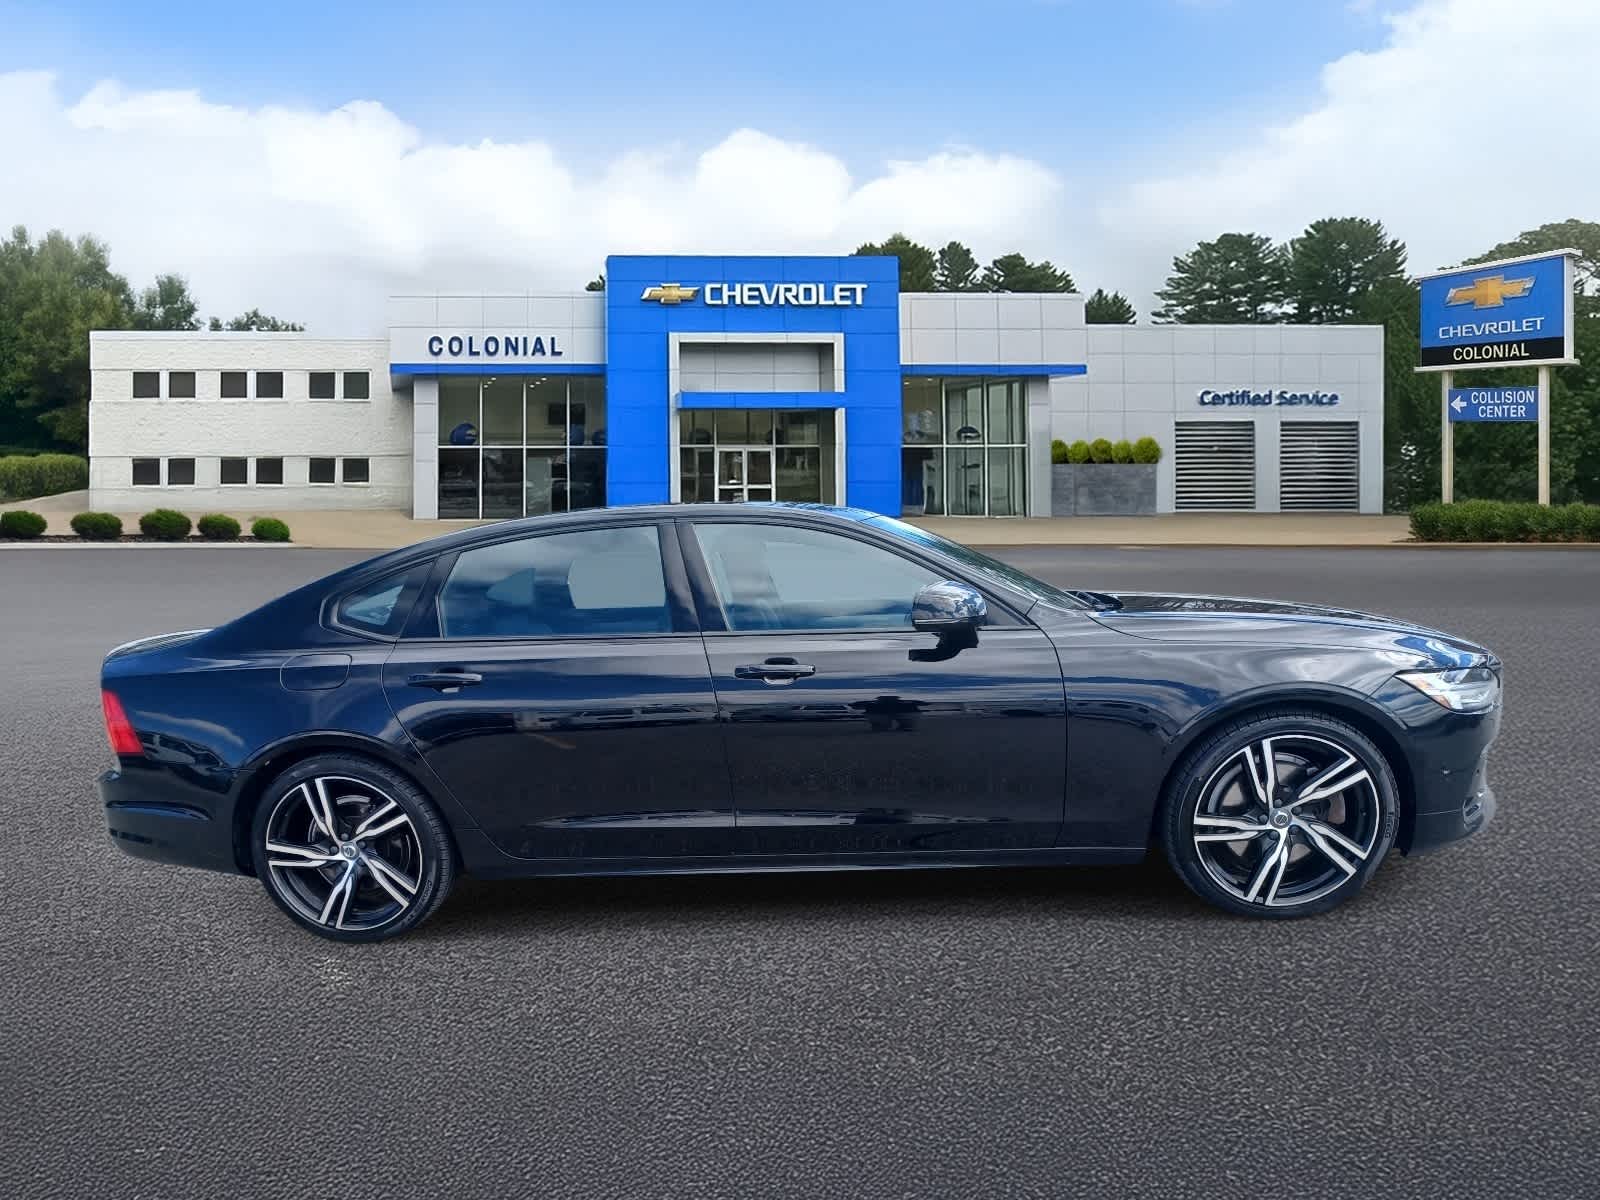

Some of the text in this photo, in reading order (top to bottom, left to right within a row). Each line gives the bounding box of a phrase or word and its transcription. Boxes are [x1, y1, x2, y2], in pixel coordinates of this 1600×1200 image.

[704, 283, 867, 306] CHEVROLET
[1438, 316, 1545, 340] CHEVROLET
[427, 335, 564, 358] COLONIAL
[1452, 342, 1530, 361] COLONIAL
[1199, 390, 1339, 406] Certified Service
[1471, 390, 1535, 404] COLLISION
[1478, 405, 1526, 418] CENTER
